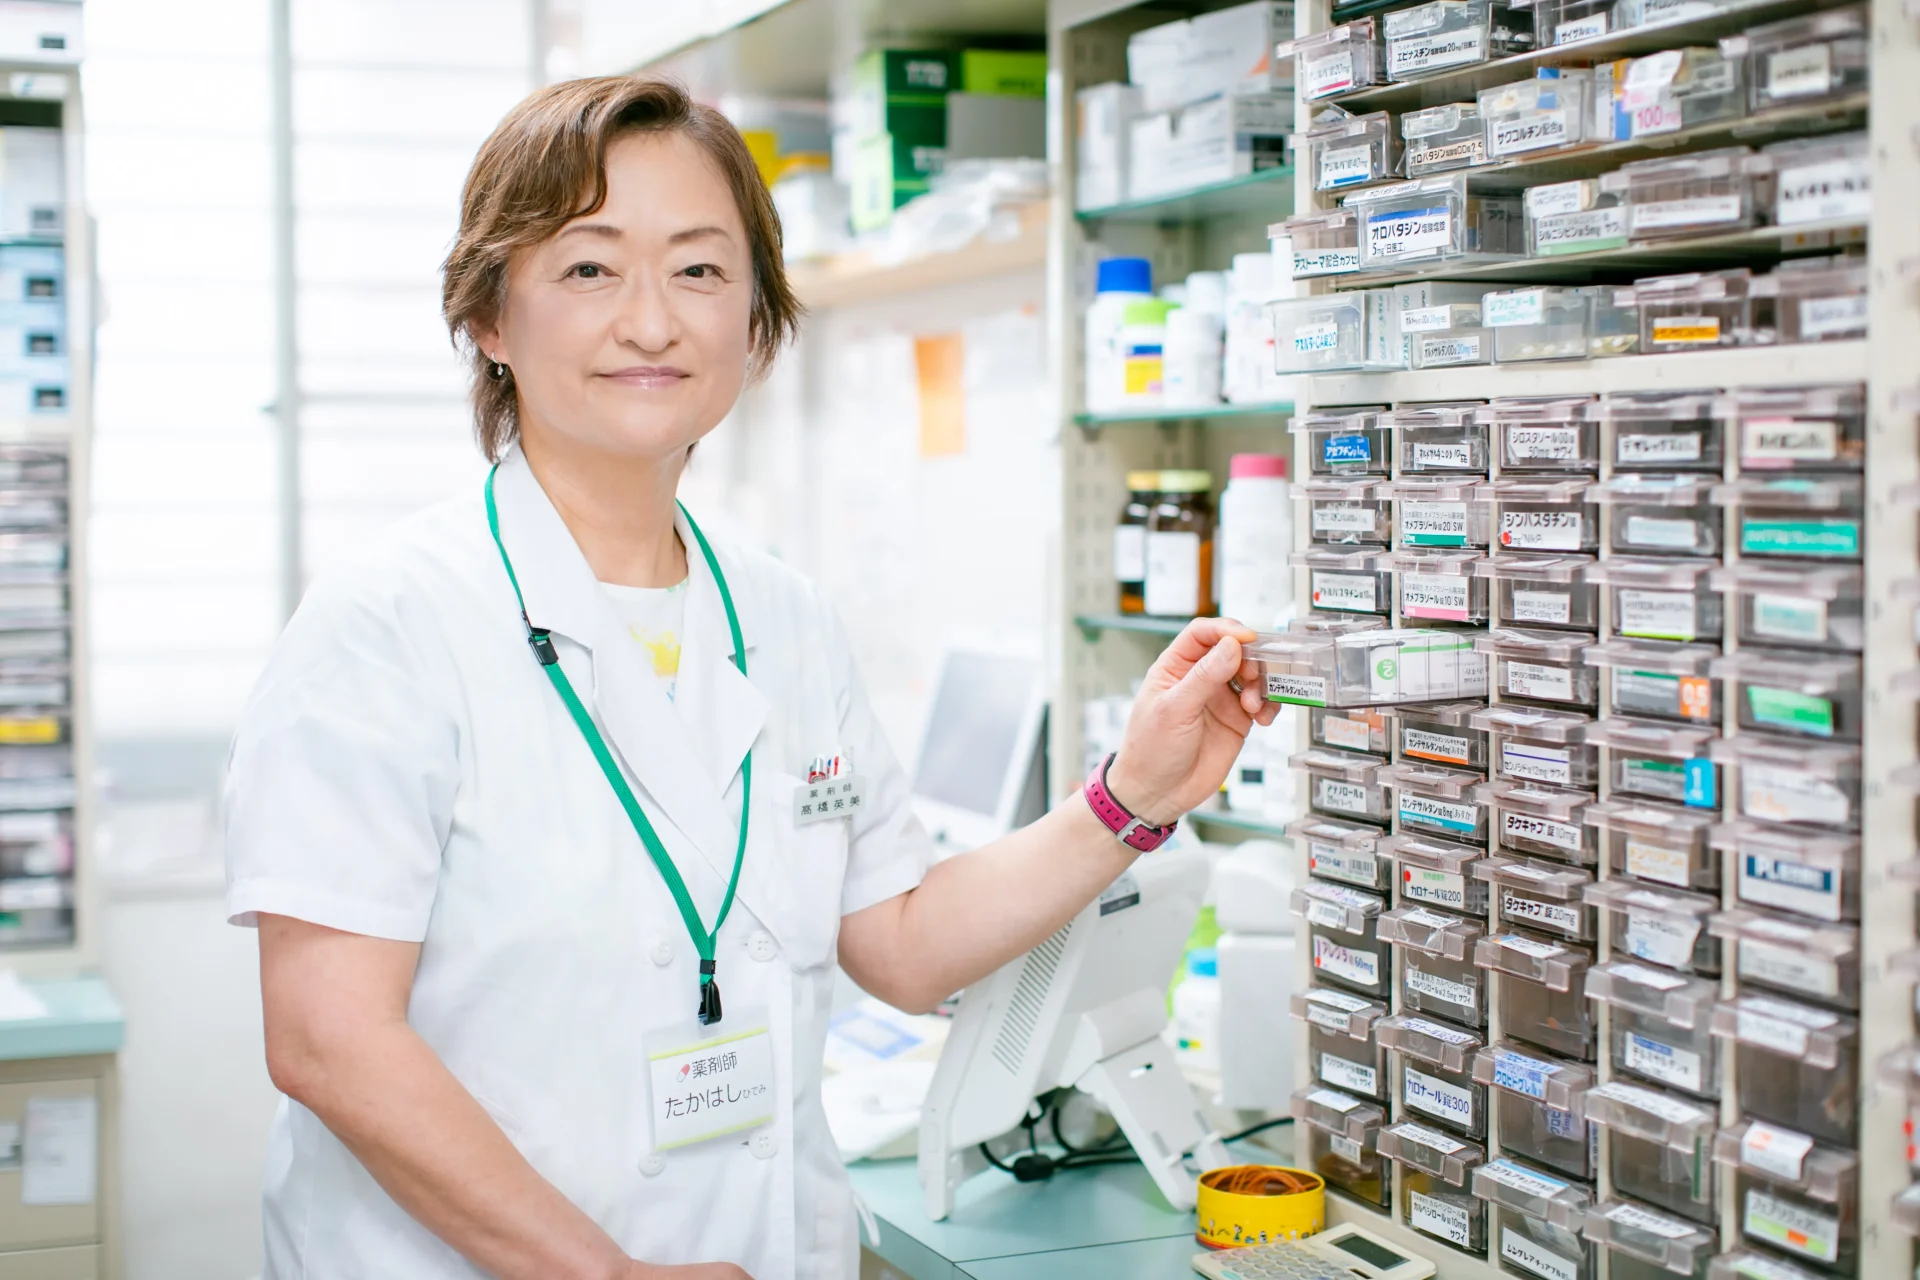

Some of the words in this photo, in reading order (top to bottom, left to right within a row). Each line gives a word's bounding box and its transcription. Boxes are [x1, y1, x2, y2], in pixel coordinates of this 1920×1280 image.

[1371, 221, 1446, 240] オロパタジン塩酸塩錠
[810, 783, 852, 798] 薬剤師
[692, 1051, 738, 1079] 薬剤師
[1407, 1078, 1470, 1115] カロナール錠300
